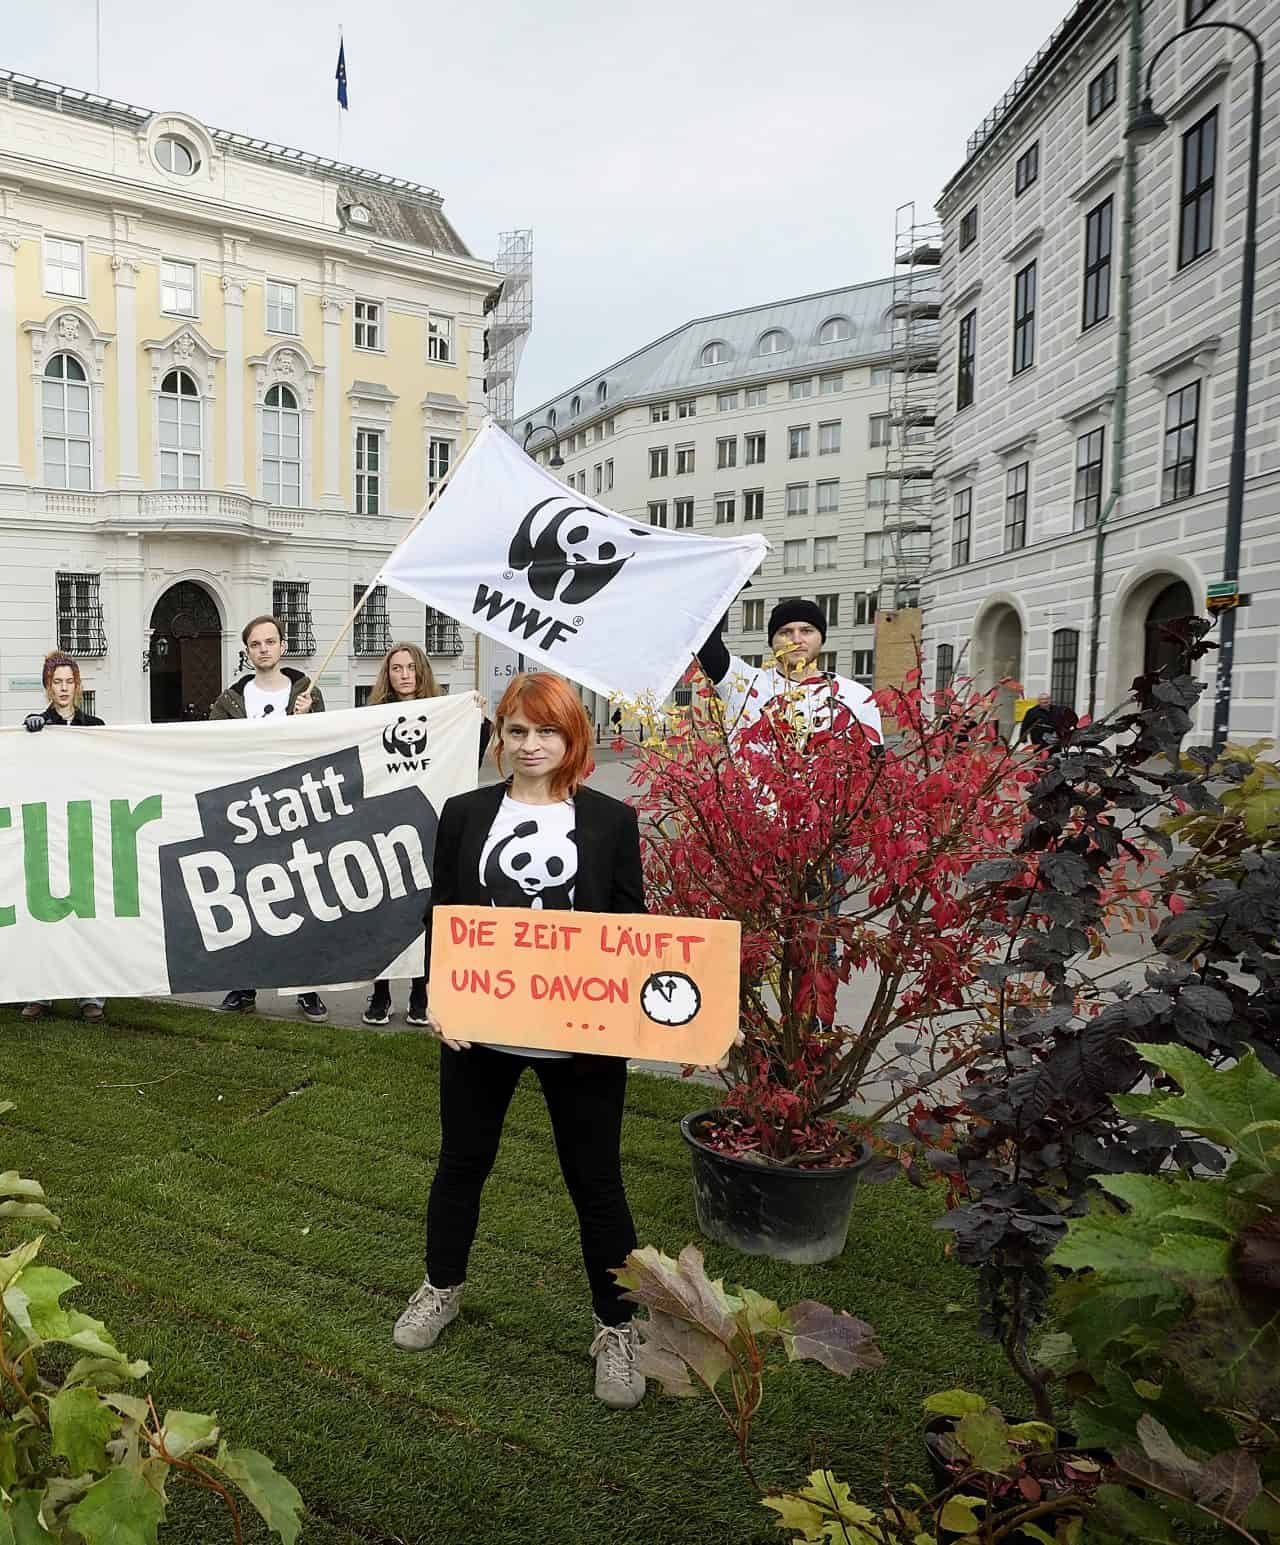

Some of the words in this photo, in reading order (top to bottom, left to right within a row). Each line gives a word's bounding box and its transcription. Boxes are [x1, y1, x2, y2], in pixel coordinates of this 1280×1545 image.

[387, 758, 431, 774] WWF
[227, 765, 354, 845] statt
[179, 823, 431, 953] Beton
[600, 925, 705, 963] LÄUFT
[451, 969, 516, 999] UNS
[530, 974, 629, 1004] DAVON
